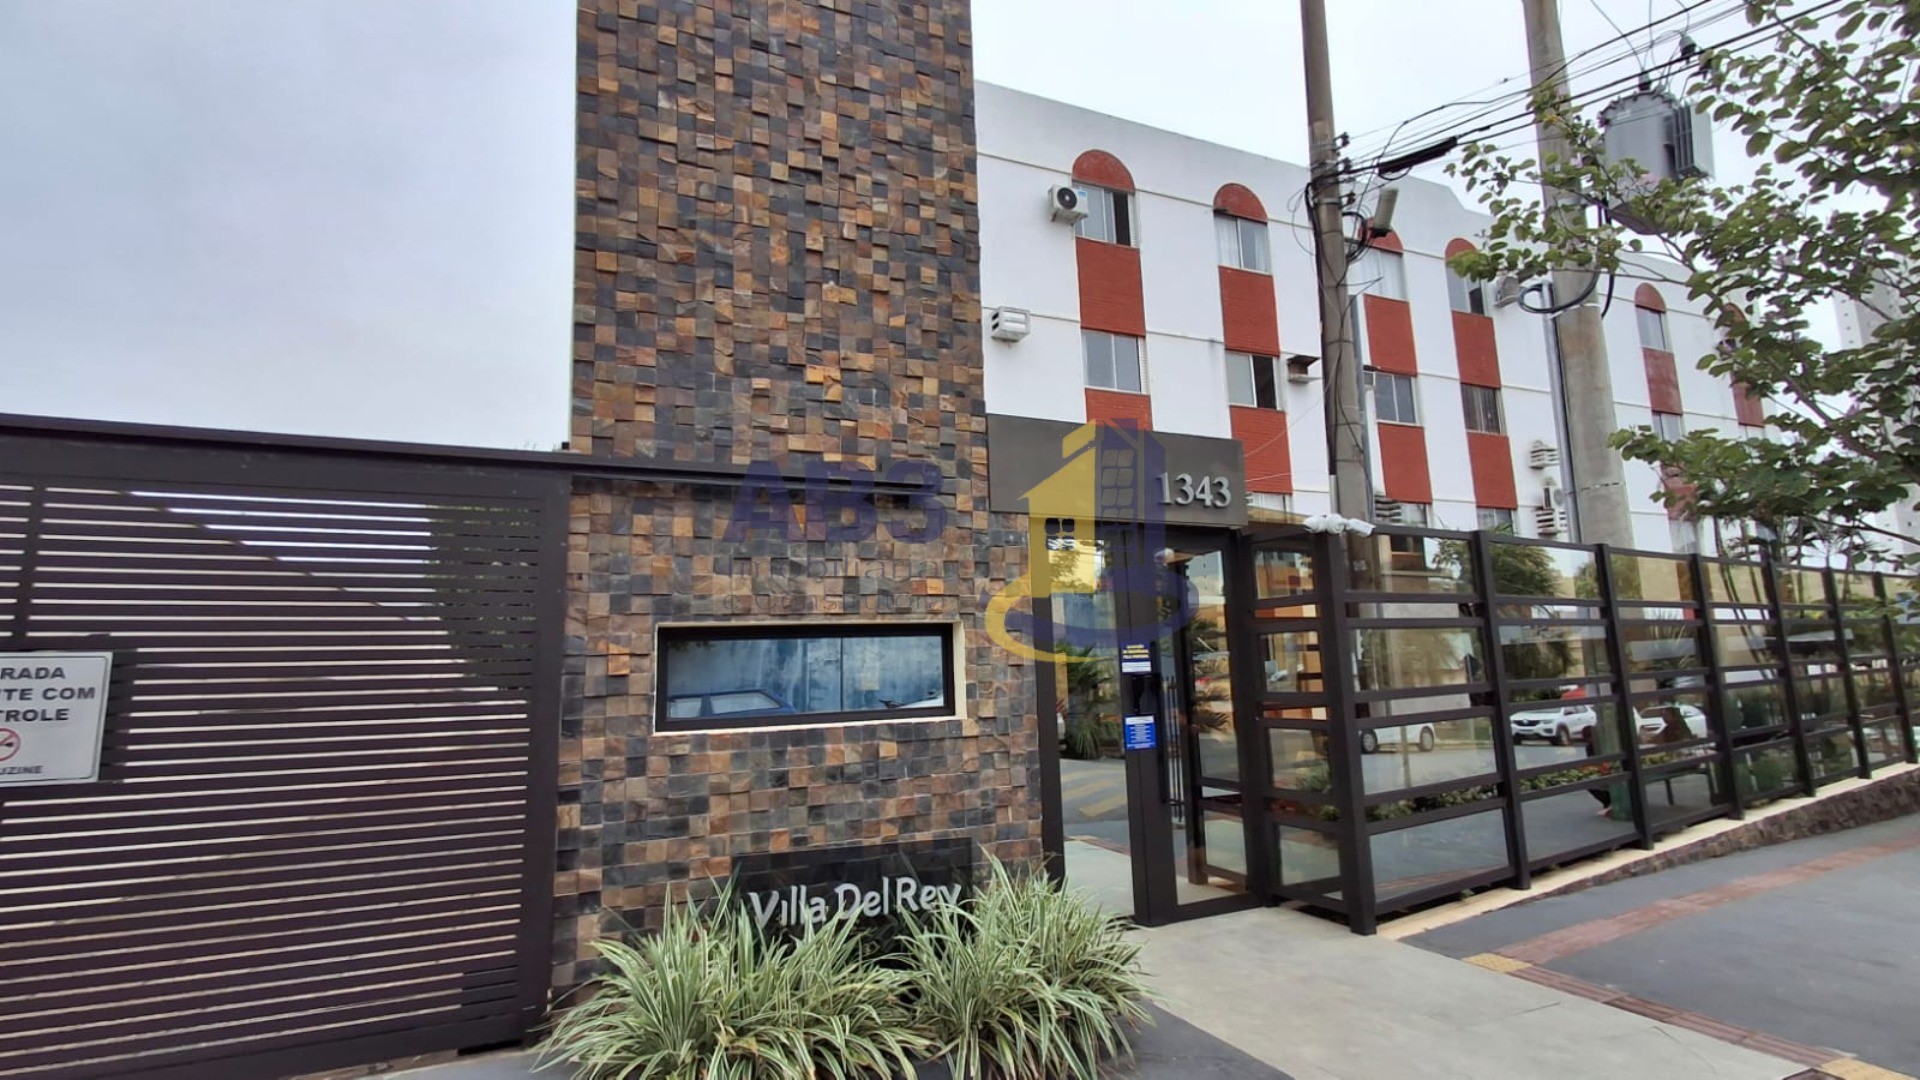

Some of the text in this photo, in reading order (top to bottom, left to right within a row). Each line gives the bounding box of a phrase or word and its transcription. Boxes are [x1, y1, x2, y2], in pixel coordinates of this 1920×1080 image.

[1156, 472, 1231, 508] 1343
[0, 687, 96, 701] TE COM
[0, 708, 70, 722] ROLE
[748, 876, 962, 929] Villa Del Rey
